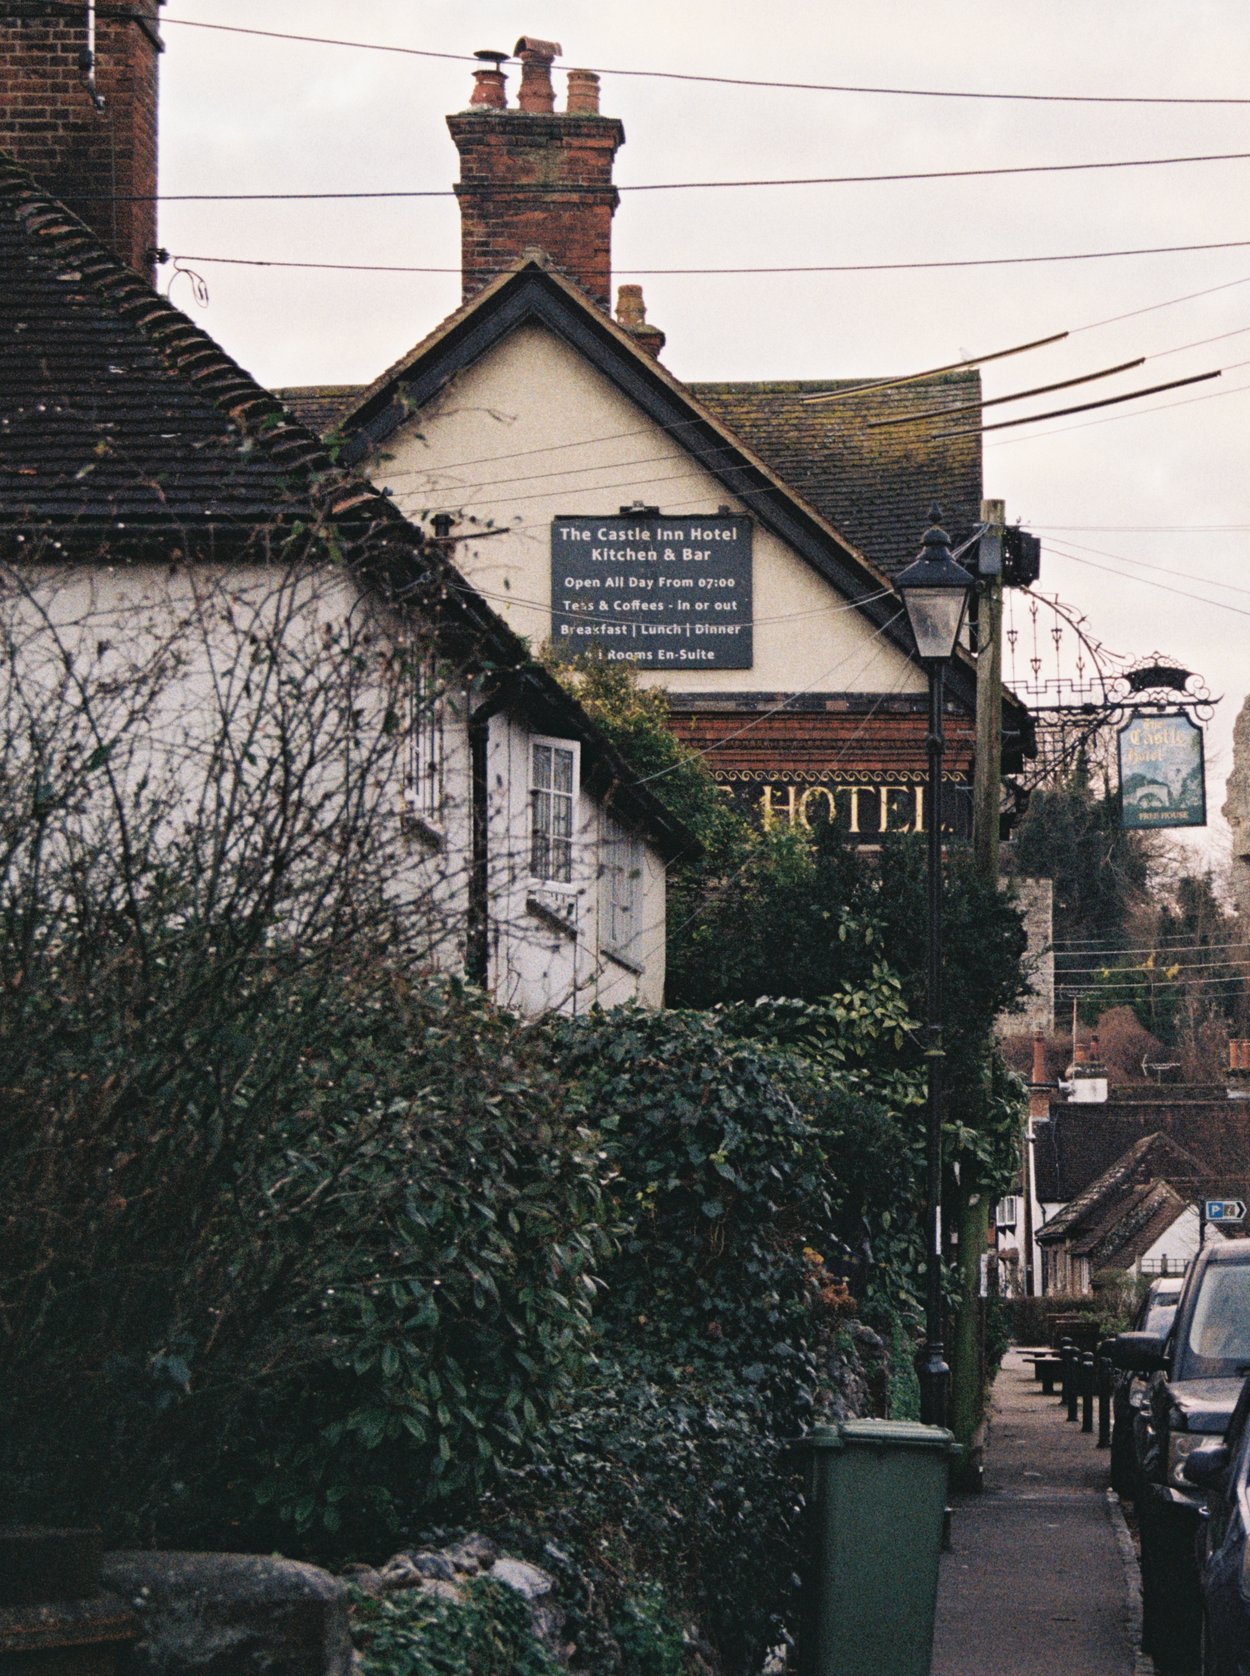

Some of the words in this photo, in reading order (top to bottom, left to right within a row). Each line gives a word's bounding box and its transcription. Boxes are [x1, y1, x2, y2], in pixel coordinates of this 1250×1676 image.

[560, 528, 591, 541] The
[598, 528, 650, 541] Castle
[657, 528, 683, 541] Inn
[691, 527, 737, 541] Hotel
[592, 548, 657, 561] Kitchen
[664, 549, 675, 561] &
[682, 549, 711, 561] Bar
[565, 577, 600, 590] Open
[605, 577, 624, 587] All
[629, 577, 654, 589] Day
[659, 577, 693, 587] From
[698, 578, 735, 588] 07:00
[563, 600, 594, 611] Teas
[599, 600, 609, 611] &
[613, 600, 664, 611] Coffees
[695, 601, 709, 610] or
[714, 601, 737, 611] out
[561, 624, 627, 635] Breakfast
[641, 624, 681, 635] Lunch
[695, 624, 741, 635] Dinner
[608, 649, 653, 661] Rooms
[658, 650, 715, 660] En-Suite
[1130, 728, 1185, 745] Castle
[1211, 1205, 1220, 1216] P
